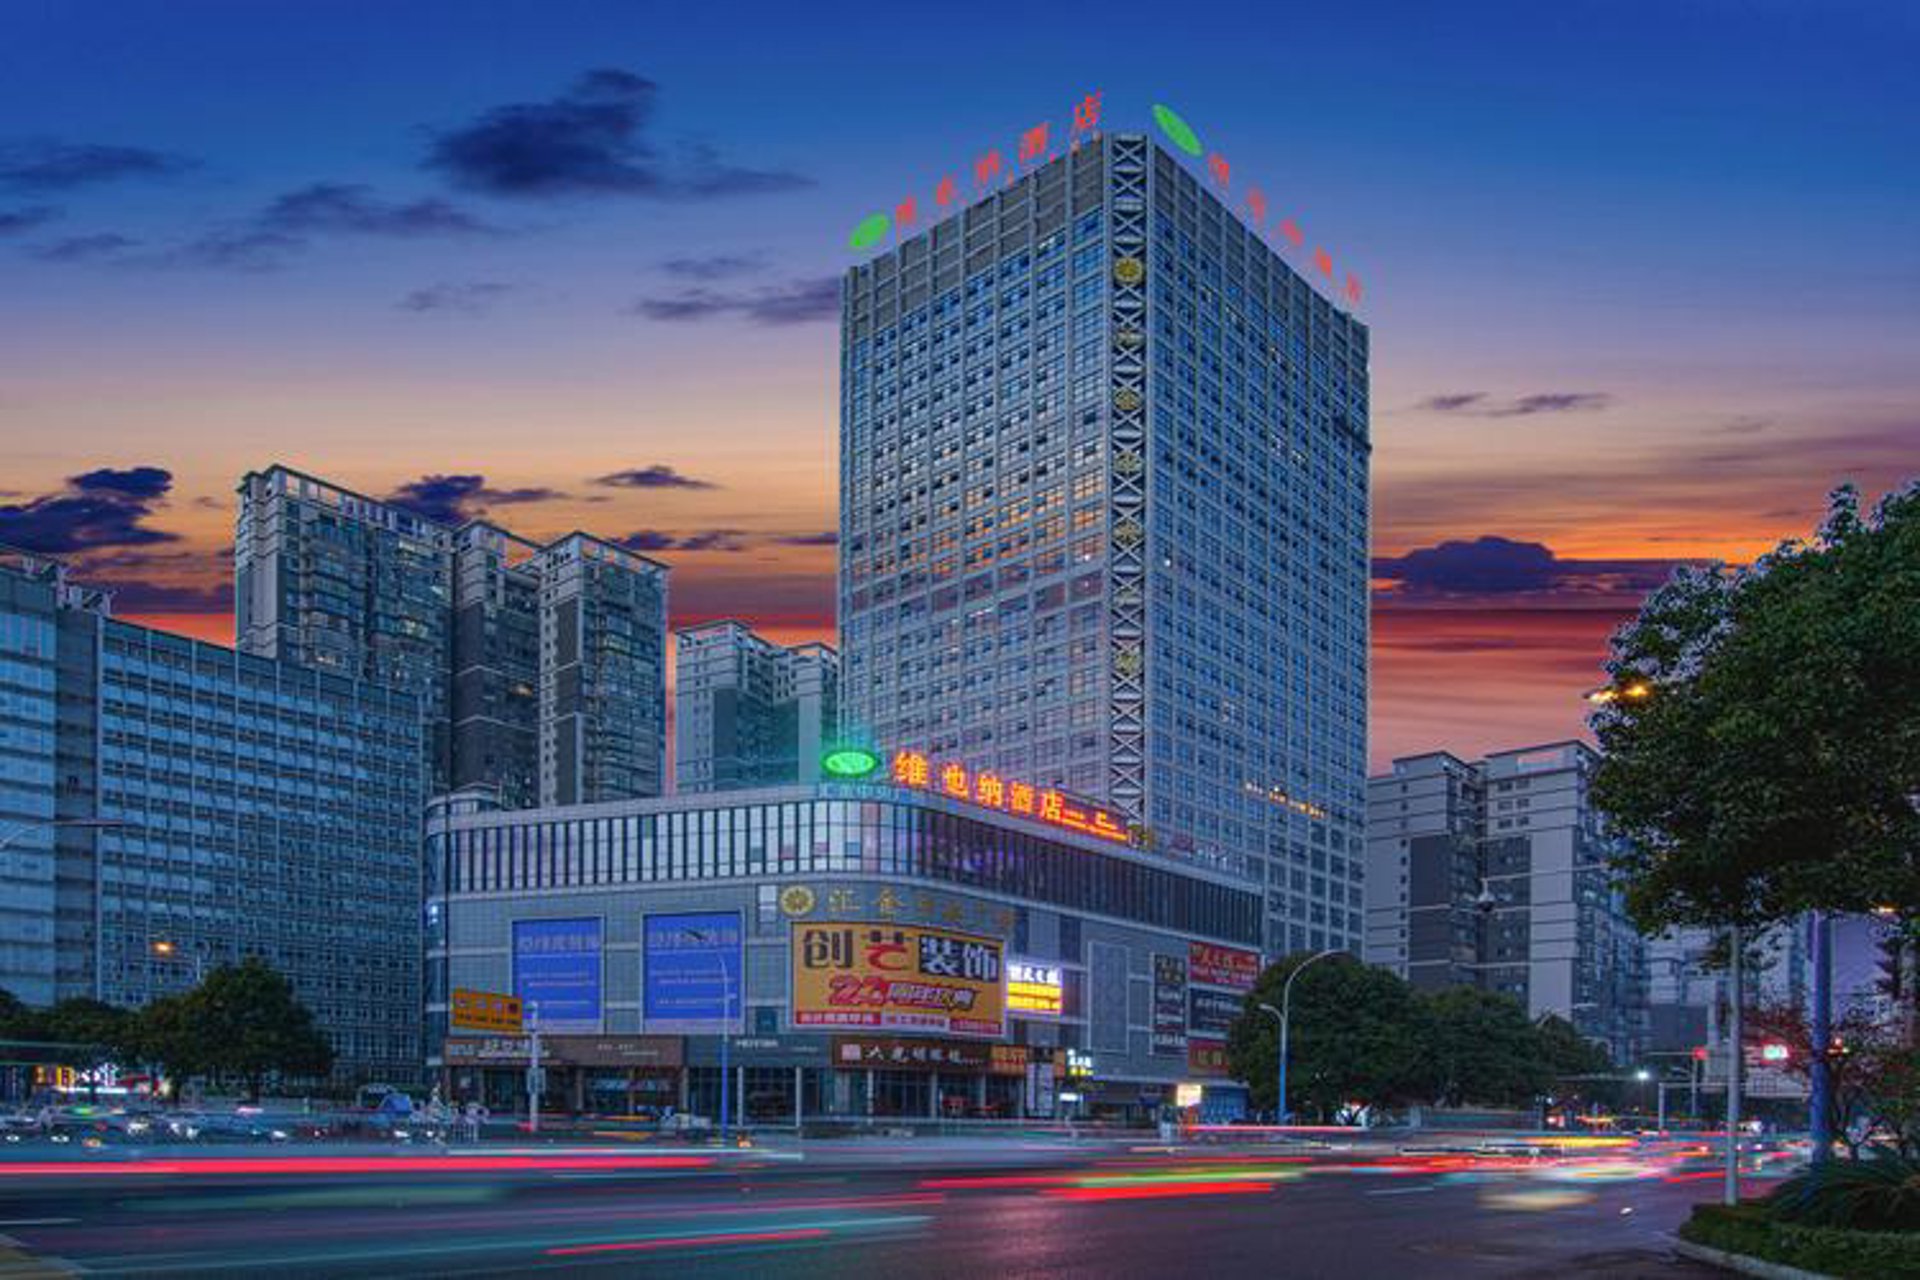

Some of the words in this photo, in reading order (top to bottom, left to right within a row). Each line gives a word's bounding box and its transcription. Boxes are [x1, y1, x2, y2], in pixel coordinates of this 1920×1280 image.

[893, 751, 1065, 822] 维也纳酒店
